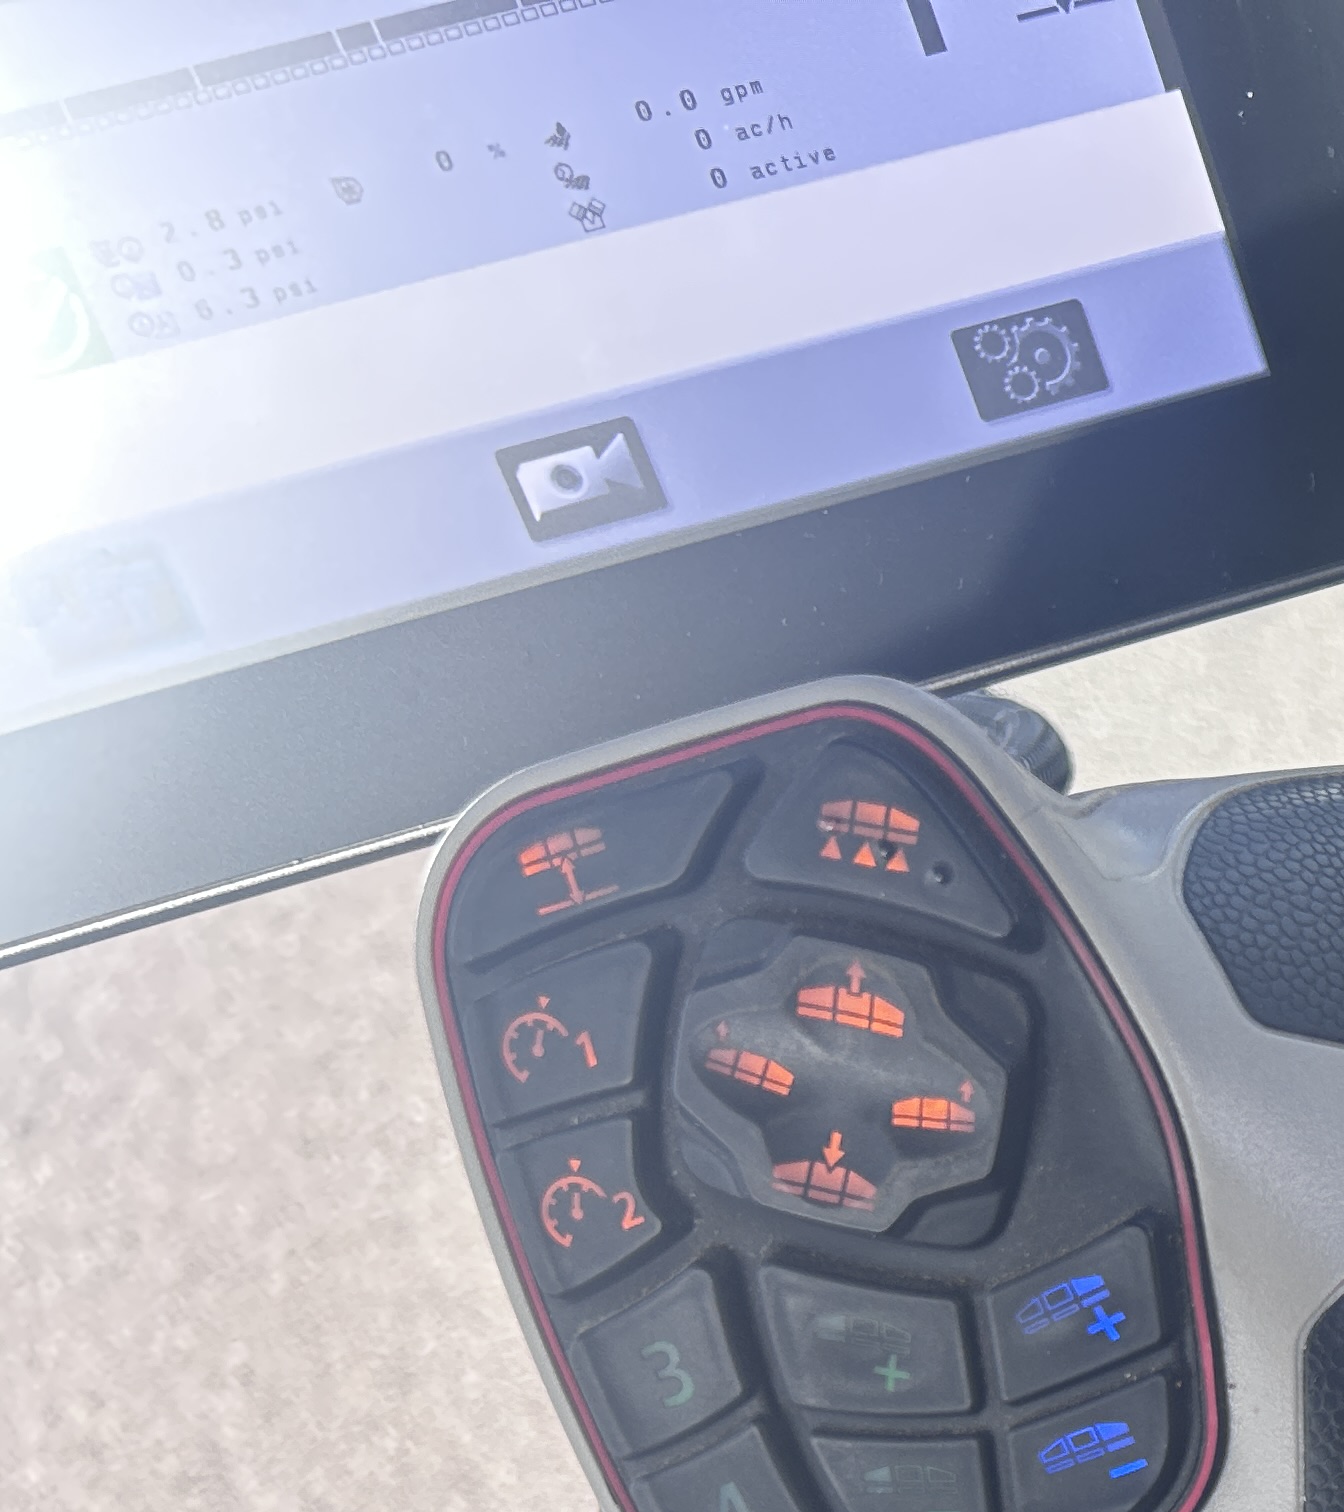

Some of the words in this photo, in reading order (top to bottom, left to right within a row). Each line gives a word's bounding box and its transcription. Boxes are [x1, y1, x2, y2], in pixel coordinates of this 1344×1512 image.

[634, 89, 697, 122] 0.0
[721, 79, 764, 106] gpm
[694, 127, 712, 150] 0
[735, 113, 793, 142] ac/h
[435, 150, 453, 172] 0
[710, 167, 727, 189] 0
[750, 146, 836, 180] active
[575, 1030, 598, 1068] 1
[611, 1190, 646, 1230] 2
[641, 1340, 695, 1407] 3
